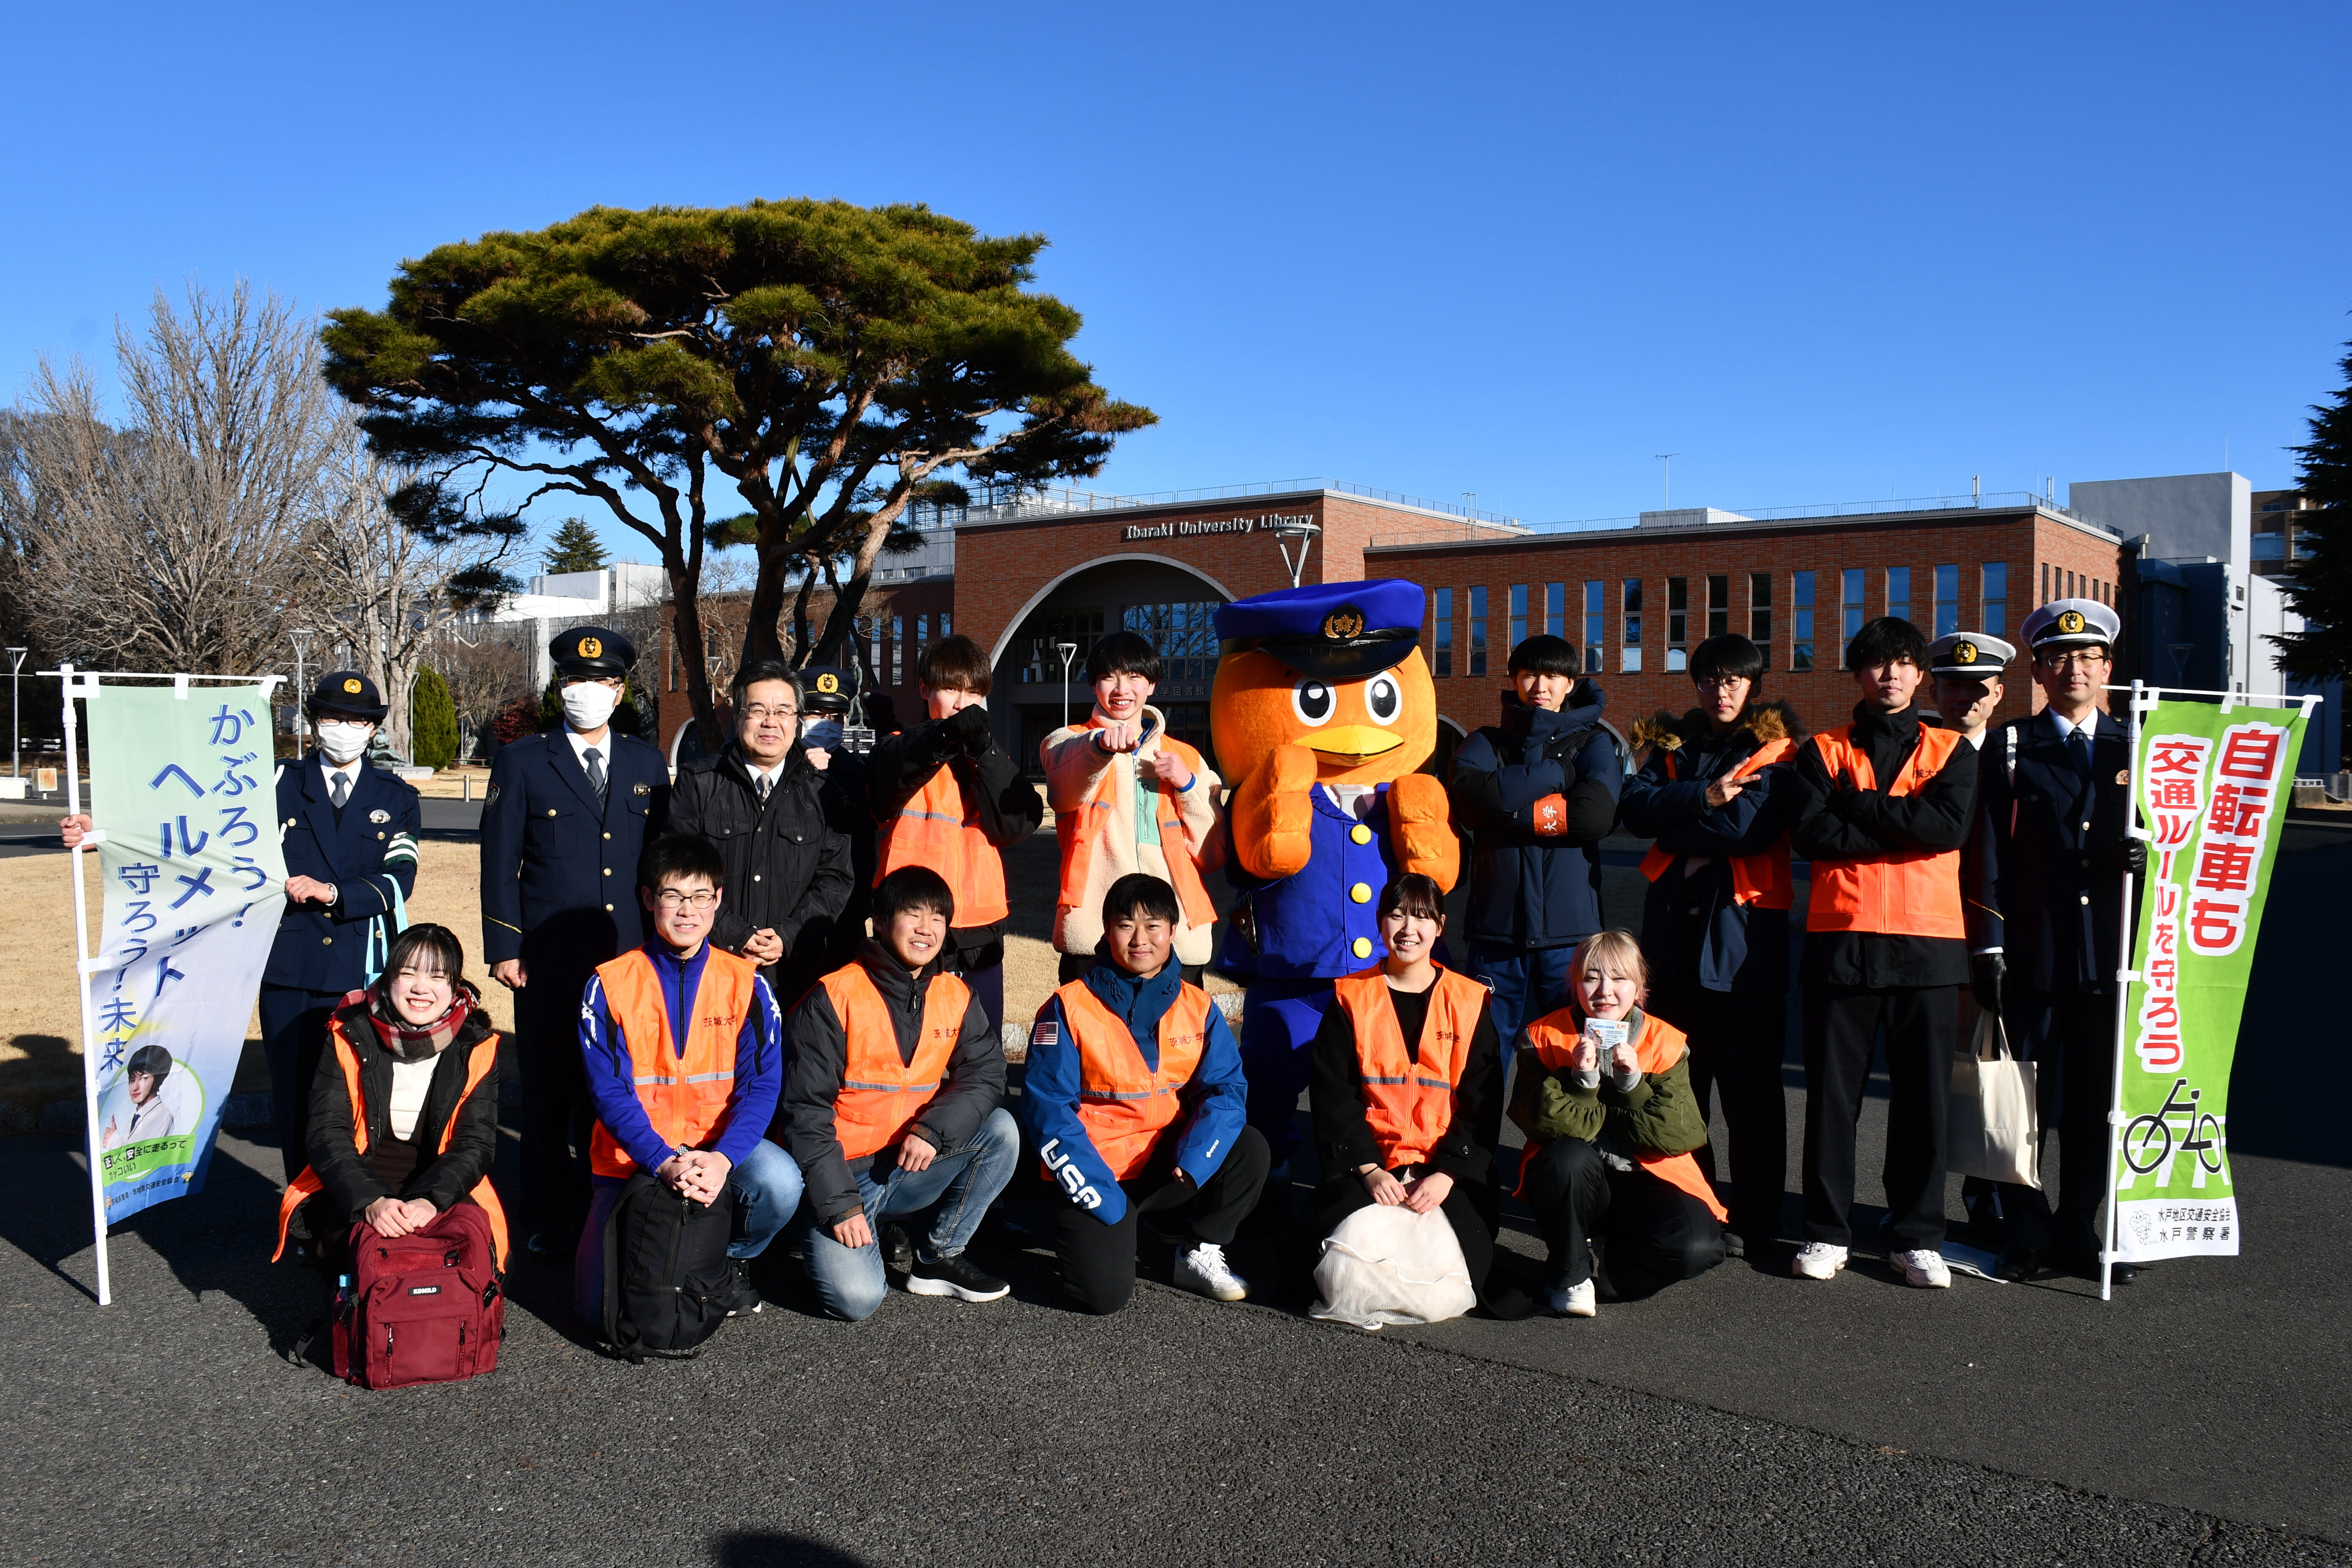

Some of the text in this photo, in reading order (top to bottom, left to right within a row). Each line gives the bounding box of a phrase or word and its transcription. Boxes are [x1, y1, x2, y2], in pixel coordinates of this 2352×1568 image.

[1126, 513, 1313, 539] Ibaraki University Library
[208, 703, 267, 929] かぶろう！
[2191, 729, 2281, 948] 自転車も
[2142, 741, 2205, 1066] 交通ルールを守ろう
[104, 1140, 187, 1170] 正しく、安全に走るって
[109, 1162, 136, 1181] カッコいい
[1041, 1138, 1102, 1209] USA
[2158, 1206, 2230, 1222] 水戸地区交通安全協会
[2159, 1226, 2230, 1242] 水戸警察署
